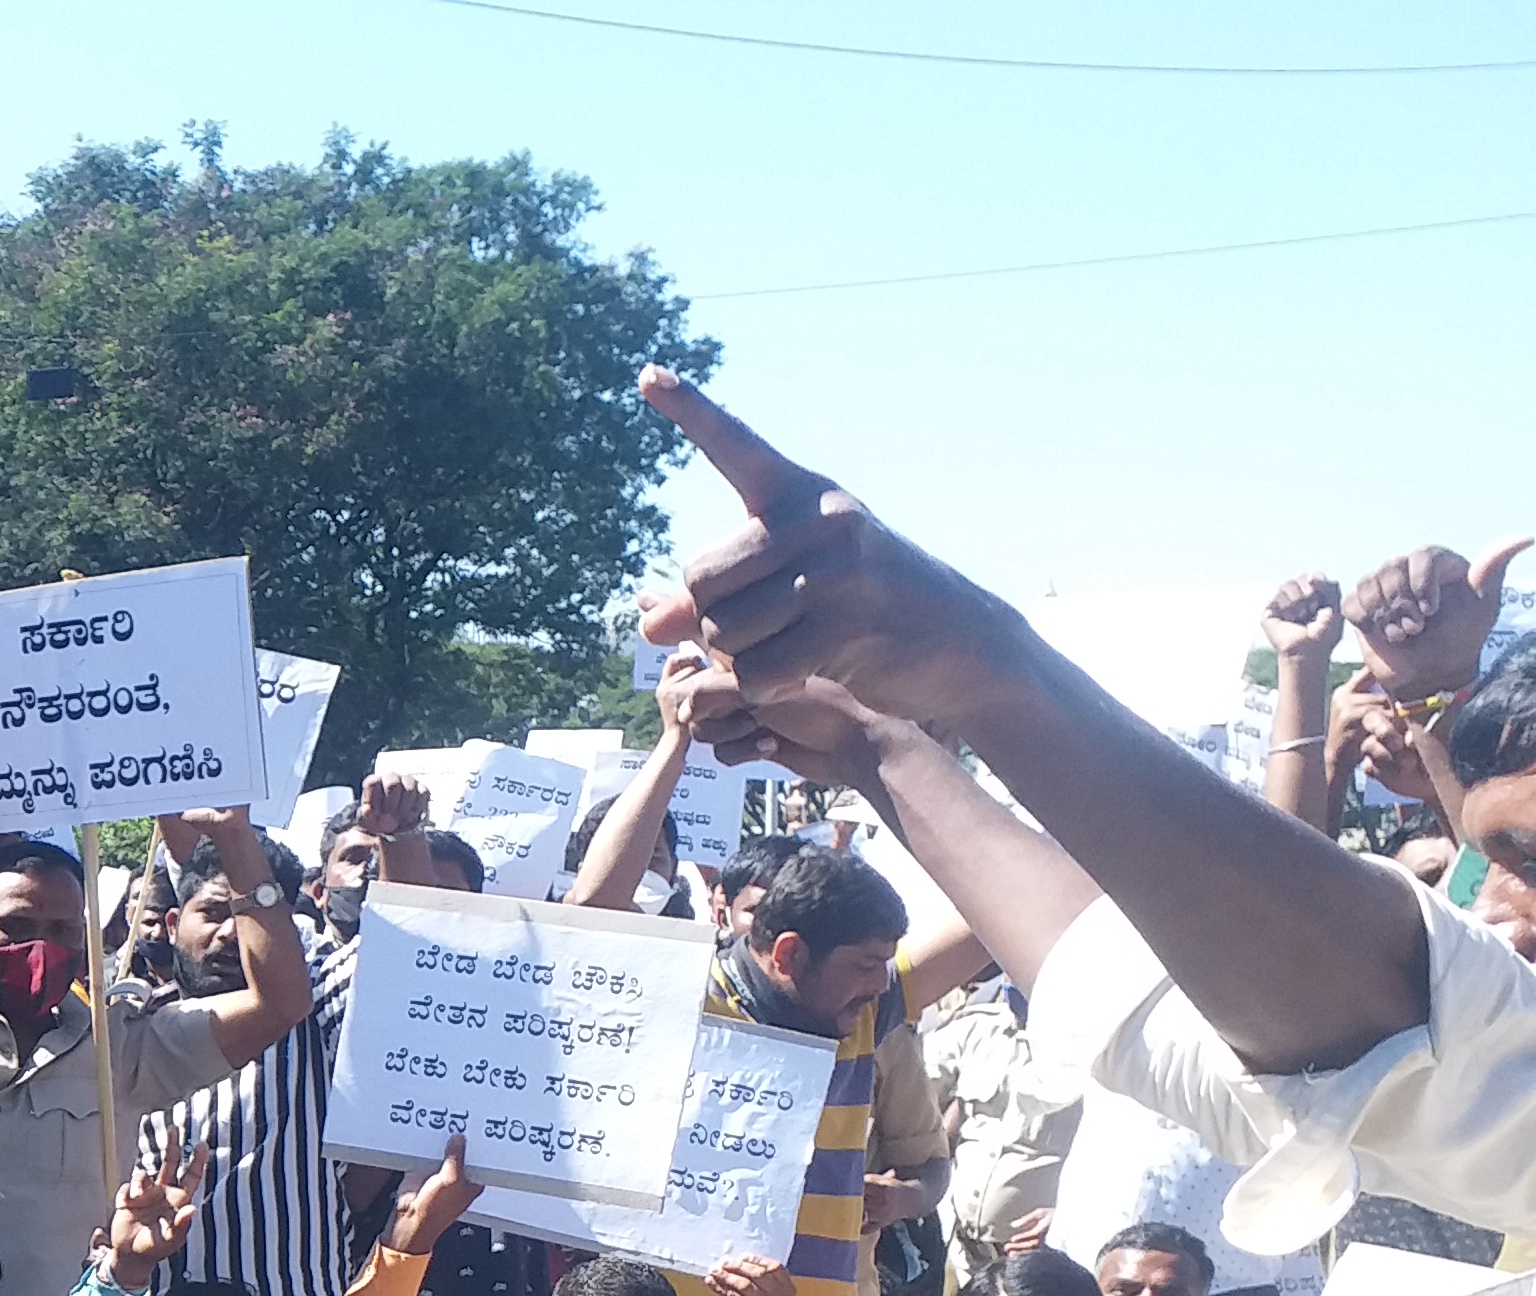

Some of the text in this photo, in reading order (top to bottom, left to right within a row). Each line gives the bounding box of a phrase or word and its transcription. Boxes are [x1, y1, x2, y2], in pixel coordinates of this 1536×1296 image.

[19, 609, 134, 655] ಸರ್ಕಾರಿ
[0, 673, 171, 730] ನೌಕರರಂತೆ,
[89, 743, 223, 790] ಪರಿಗಣಿಸಿ
[492, 775, 572, 806] ಸರ್ಕಾರದ
[415, 945, 479, 976] ಬೇಡ
[492, 954, 556, 986] ಬೇಡ
[408, 995, 634, 1055] ವೇತನ ಪರಿಷ್ಕರಣೆ!
[385, 1047, 636, 1106] ಬೇಕು ಬೇಕು ಸರ್ಕಾರಿ
[708, 1076, 794, 1111] ಸರ್ಕಾರಿ
[389, 1100, 611, 1162] ವೇತನ ಪರಿಷ್ಕರಣೆ.
[689, 1122, 776, 1159] ನೀಡಲು
